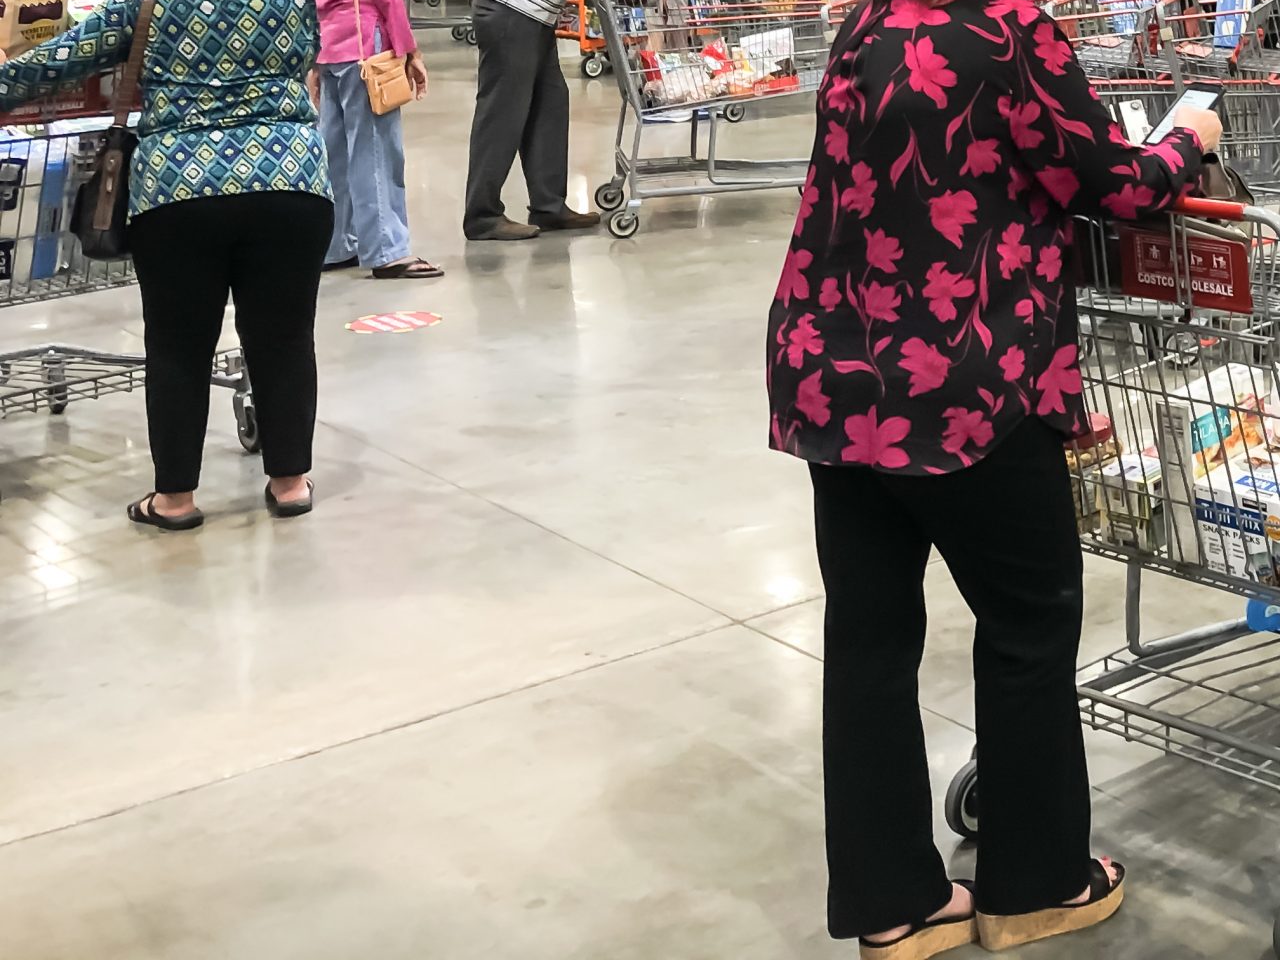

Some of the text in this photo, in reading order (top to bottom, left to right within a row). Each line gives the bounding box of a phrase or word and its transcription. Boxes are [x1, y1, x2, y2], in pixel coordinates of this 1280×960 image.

[1137, 272, 1234, 297] COSTCO OLESALE
[1194, 416, 1231, 442] TILAIA
